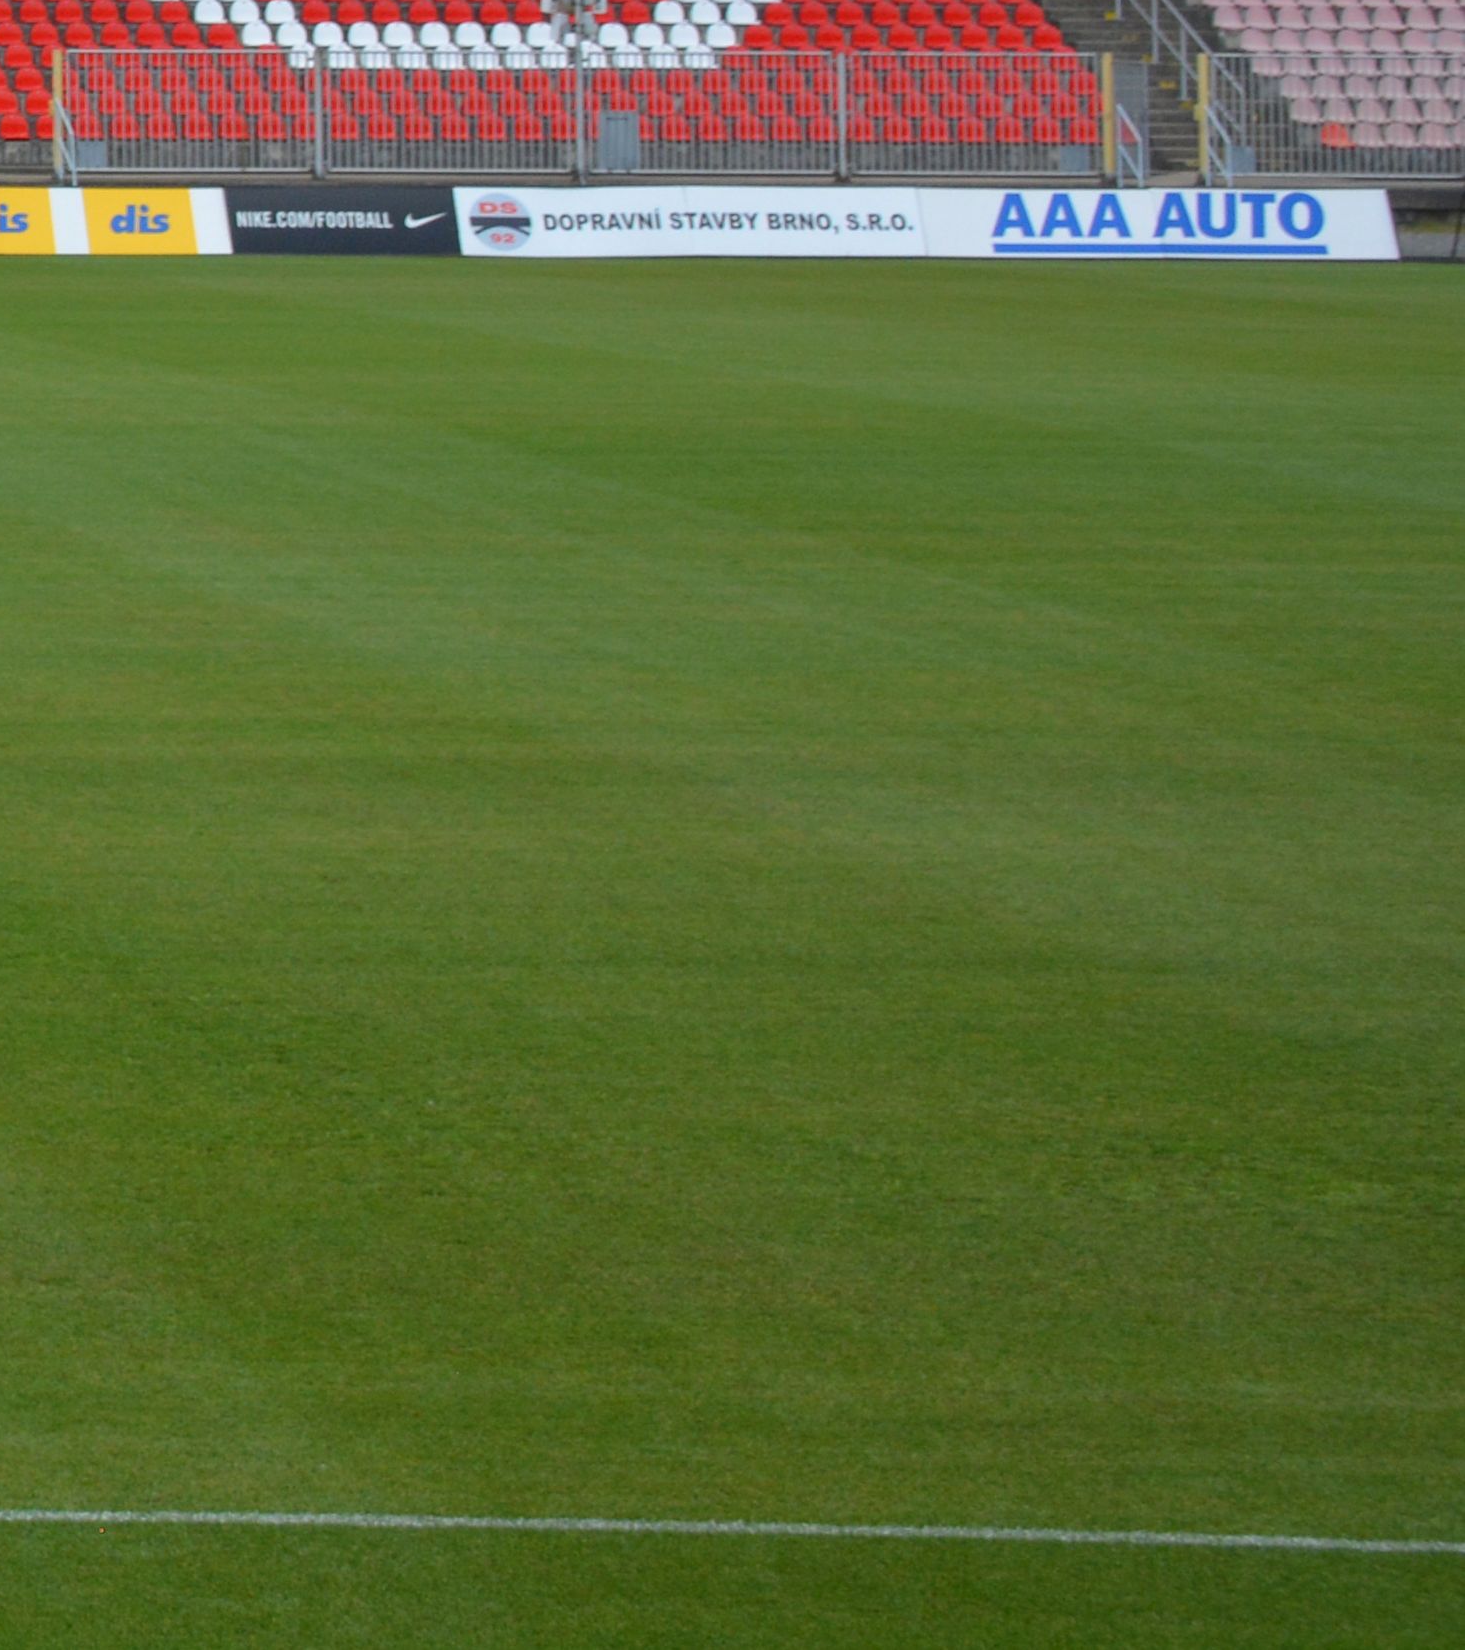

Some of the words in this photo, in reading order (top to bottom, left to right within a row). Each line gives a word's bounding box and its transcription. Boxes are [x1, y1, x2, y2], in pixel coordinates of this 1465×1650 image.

[478, 202, 518, 214] DS
[992, 193, 1132, 238] AAA
[1153, 192, 1325, 239] AUTO
[110, 205, 170, 234] dis
[235, 210, 394, 230] NIKE.COM/FOOTBALL
[543, 208, 662, 231] DOPRAVNÍ
[669, 212, 758, 230] STAVBY
[766, 212, 839, 233] BRNO,
[846, 213, 914, 231] S.R.O.
[490, 232, 516, 243] 92
